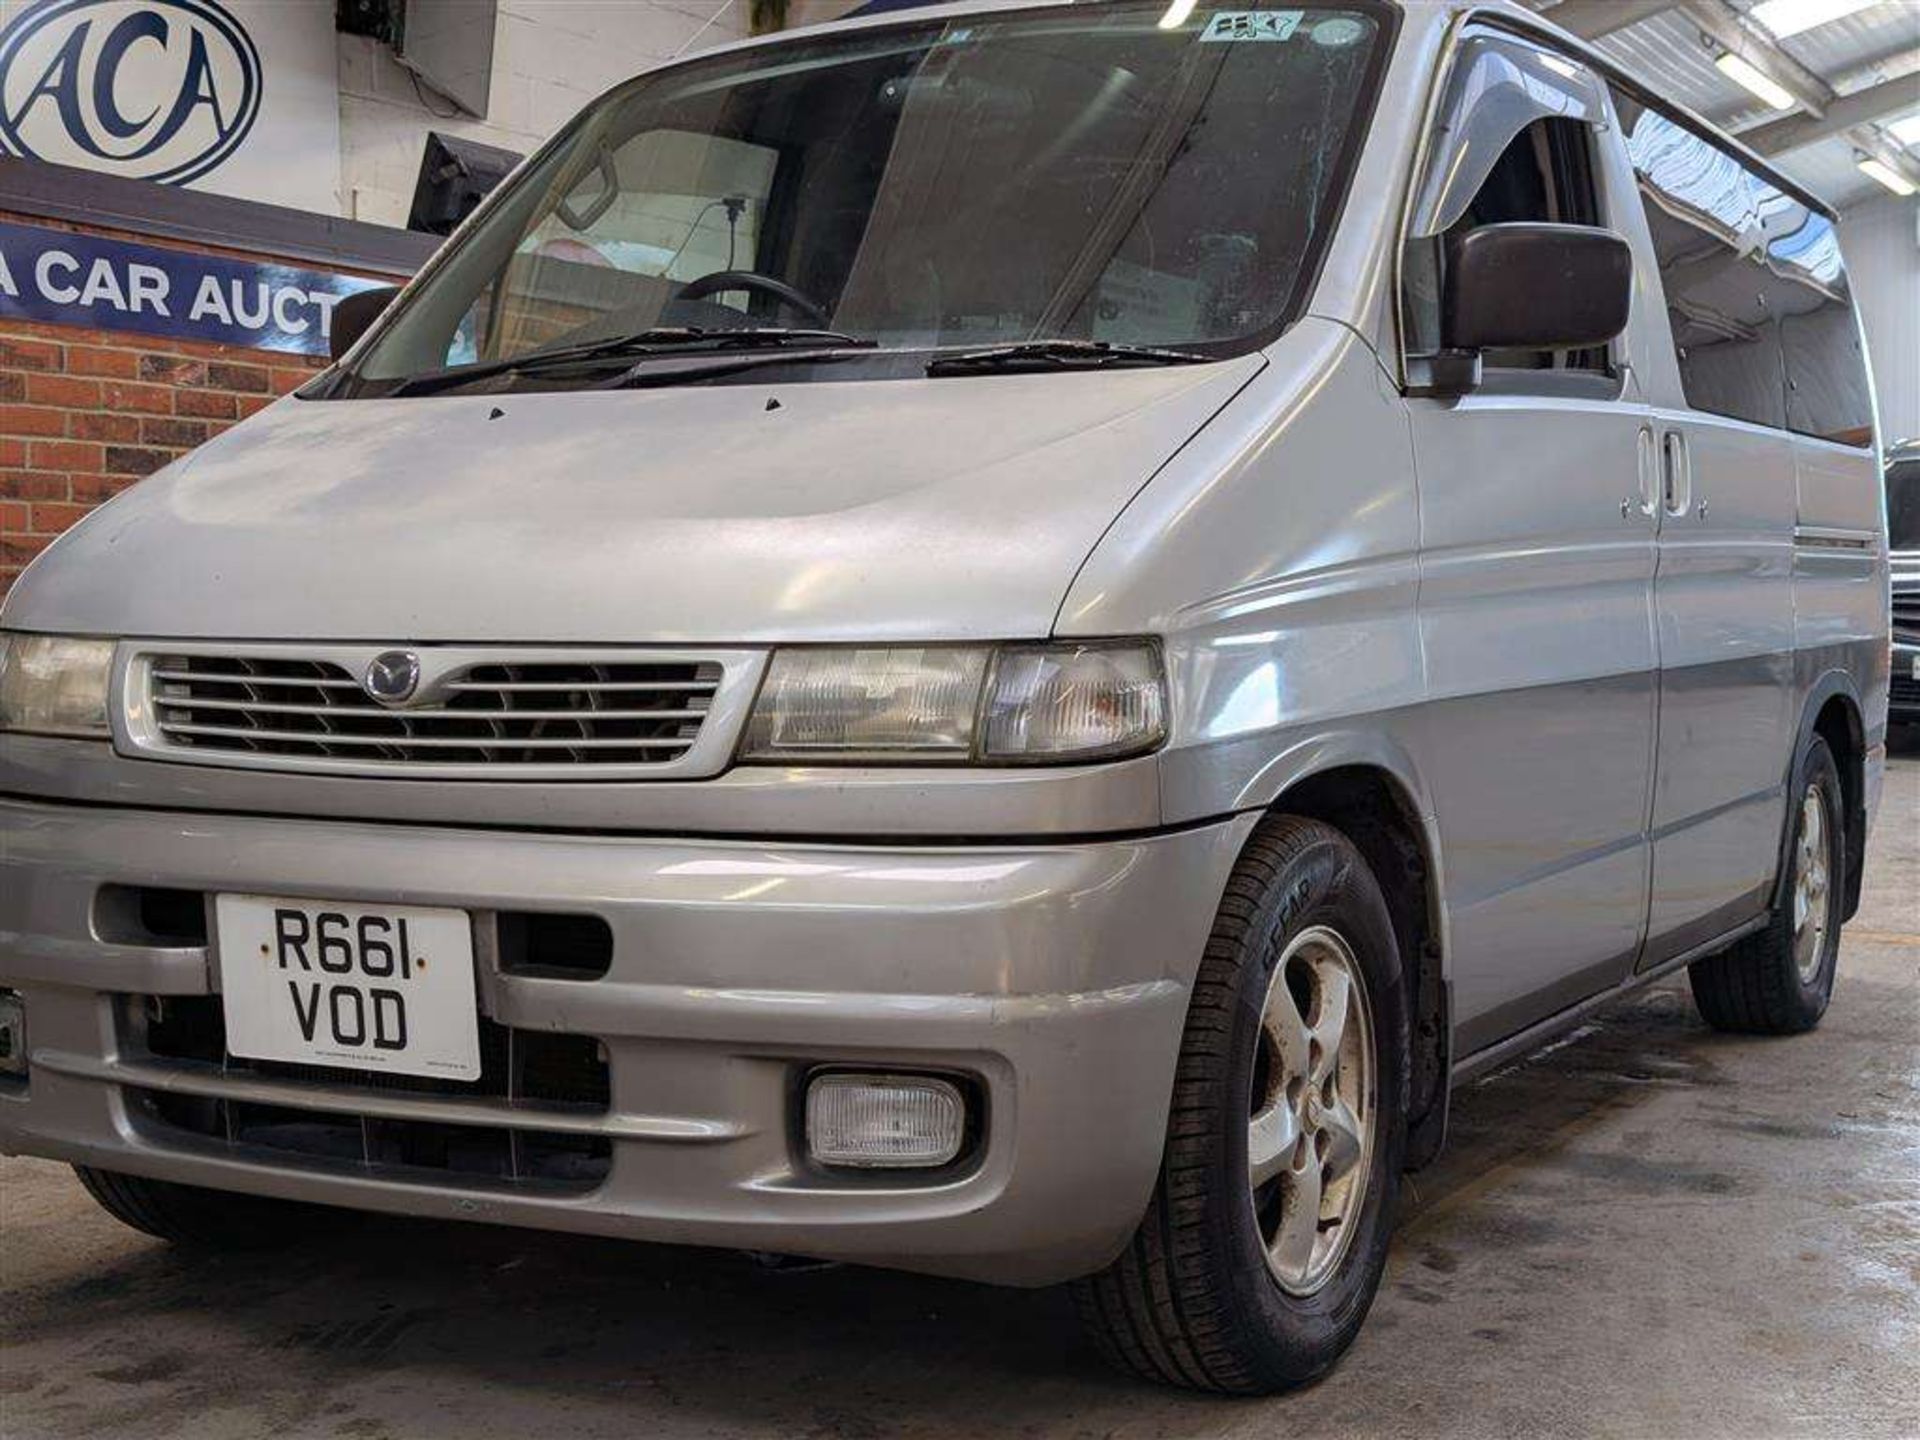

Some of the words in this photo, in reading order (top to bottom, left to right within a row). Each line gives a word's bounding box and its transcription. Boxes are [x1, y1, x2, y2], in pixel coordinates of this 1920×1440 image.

[8, 10, 228, 161] ACA
[35, 251, 170, 317] CAR
[275, 909, 410, 979] R661
[289, 981, 407, 1050] VOD
